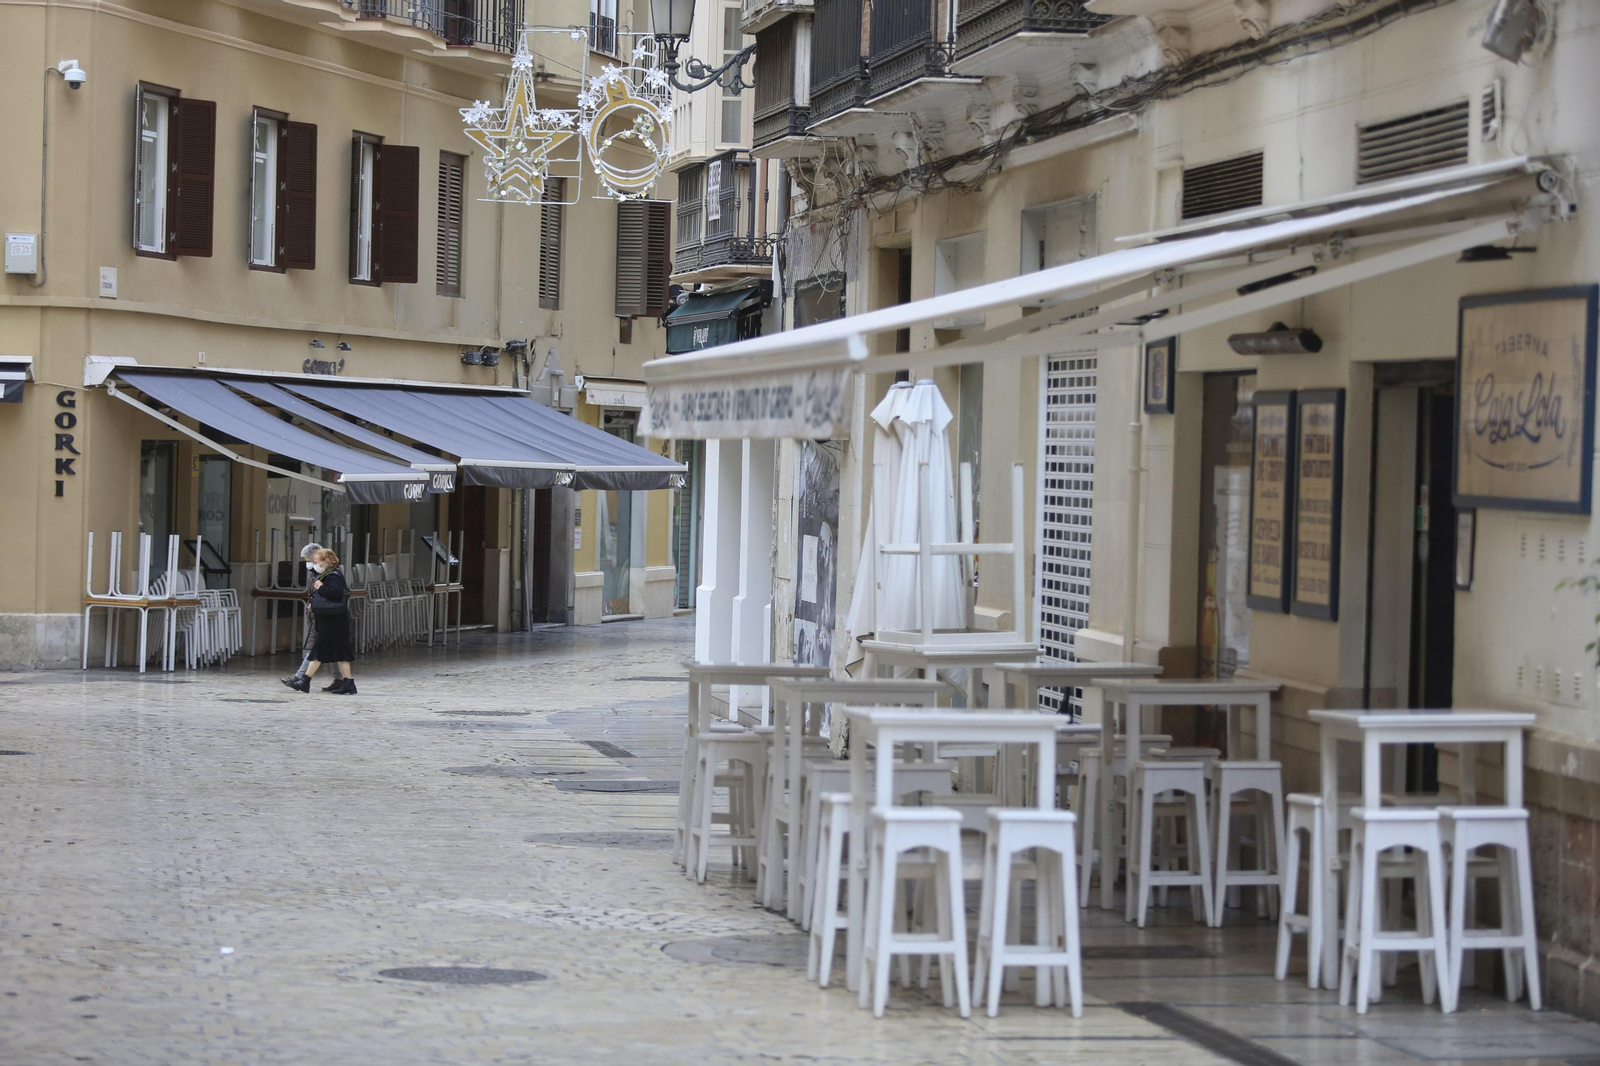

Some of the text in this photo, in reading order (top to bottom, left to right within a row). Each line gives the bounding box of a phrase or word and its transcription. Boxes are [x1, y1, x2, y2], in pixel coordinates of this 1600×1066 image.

[1495, 334, 1549, 360] TABERNA
[1515, 371, 1565, 445] Lola
[54, 390, 81, 497] GORKI
[267, 494, 297, 515] GORKI
